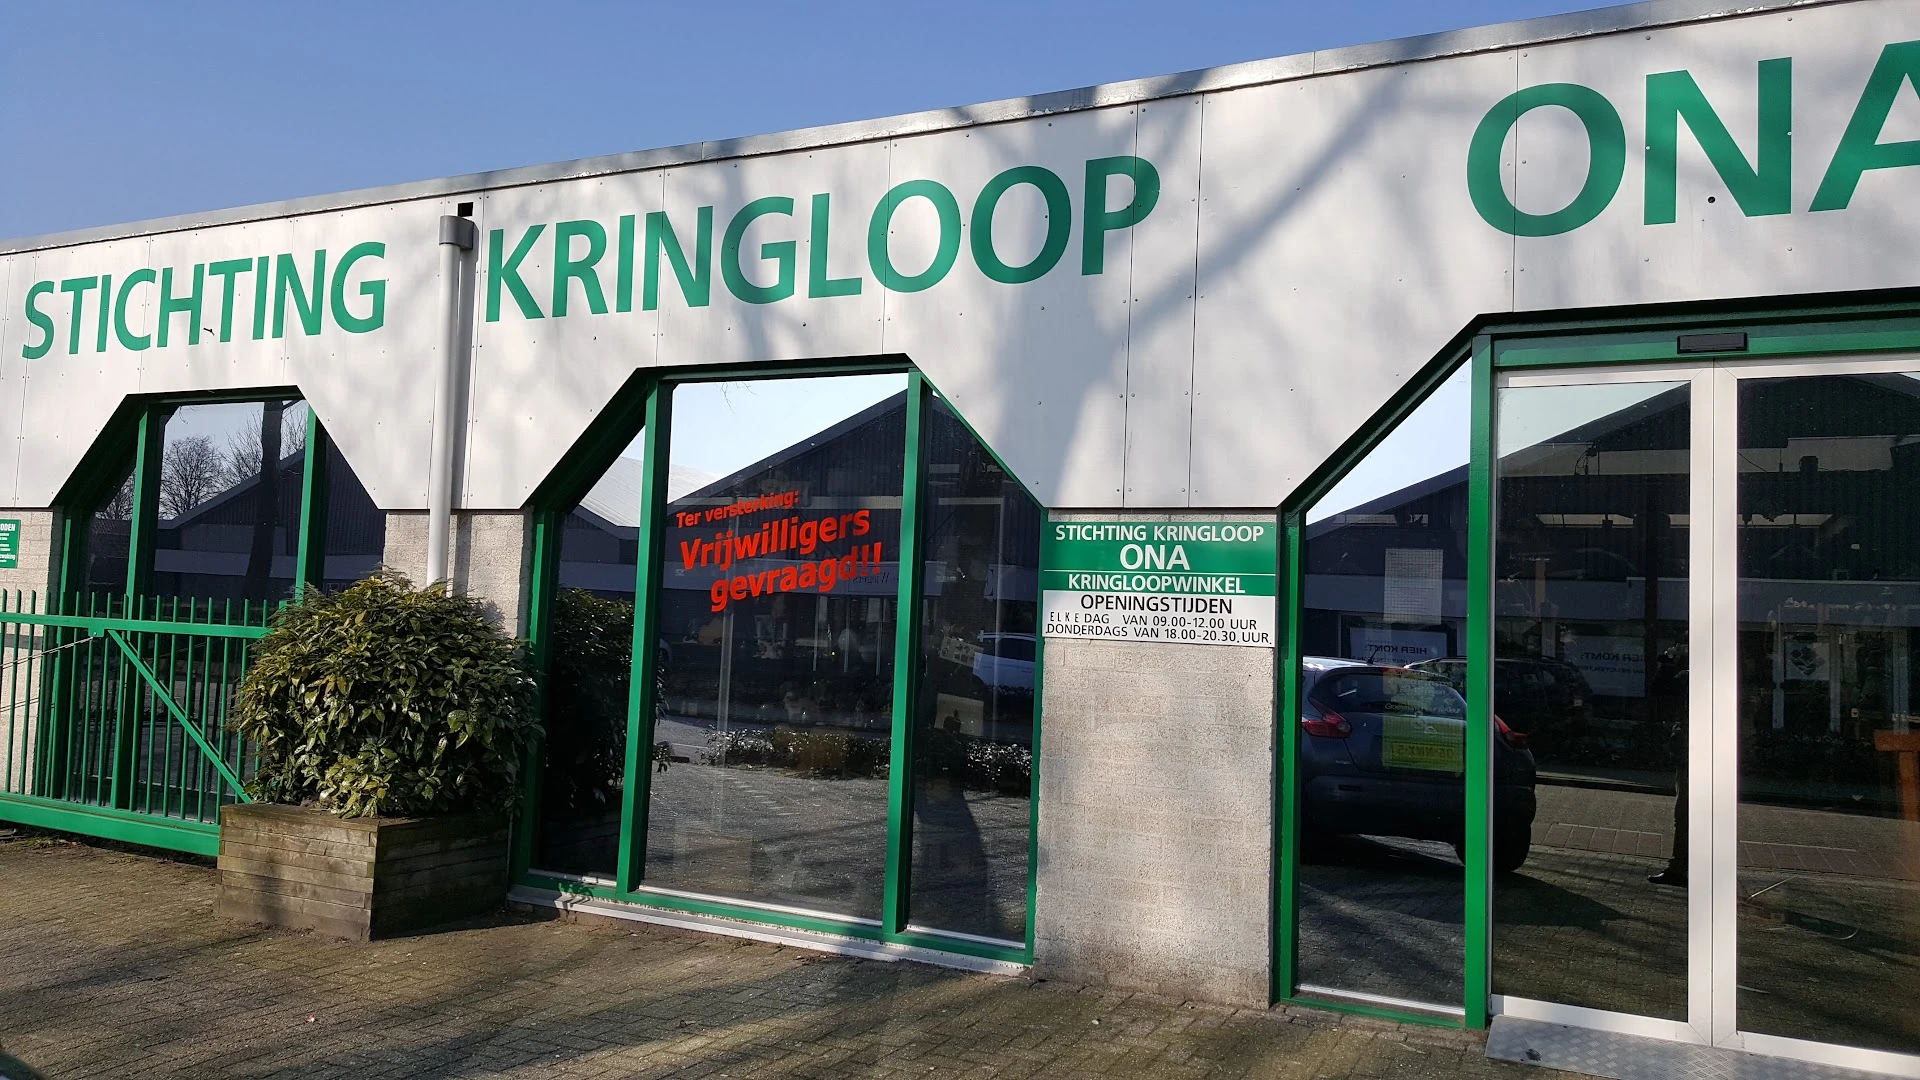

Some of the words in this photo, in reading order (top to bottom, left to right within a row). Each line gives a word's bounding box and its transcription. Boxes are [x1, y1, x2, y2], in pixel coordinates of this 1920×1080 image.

[23, 242, 386, 359] STICHTING
[486, 156, 1161, 322] KRINGLOOP
[1468, 41, 1920, 236] ONA
[676, 512, 701, 528] Ter
[705, 490, 799, 522] versterking:
[681, 509, 870, 571] Vrijwilligers
[1055, 524, 1147, 541] STICHTING
[1153, 525, 1264, 542] KRINGLOOP
[1119, 543, 1191, 571] ONA
[711, 541, 882, 612] gevraagd!!
[1068, 573, 1246, 594] KRINGLOOPWINKEL
[1080, 594, 1232, 614] OPENINGSTIJDEN
[1046, 623, 1128, 637] DONDERDAGS
[1133, 626, 1159, 639] VAN
[1084, 613, 1110, 624] DAG
[1122, 614, 1148, 626] VAN
[1152, 615, 1225, 629] 09.00-12.00
[1230, 618, 1257, 630] UUR
